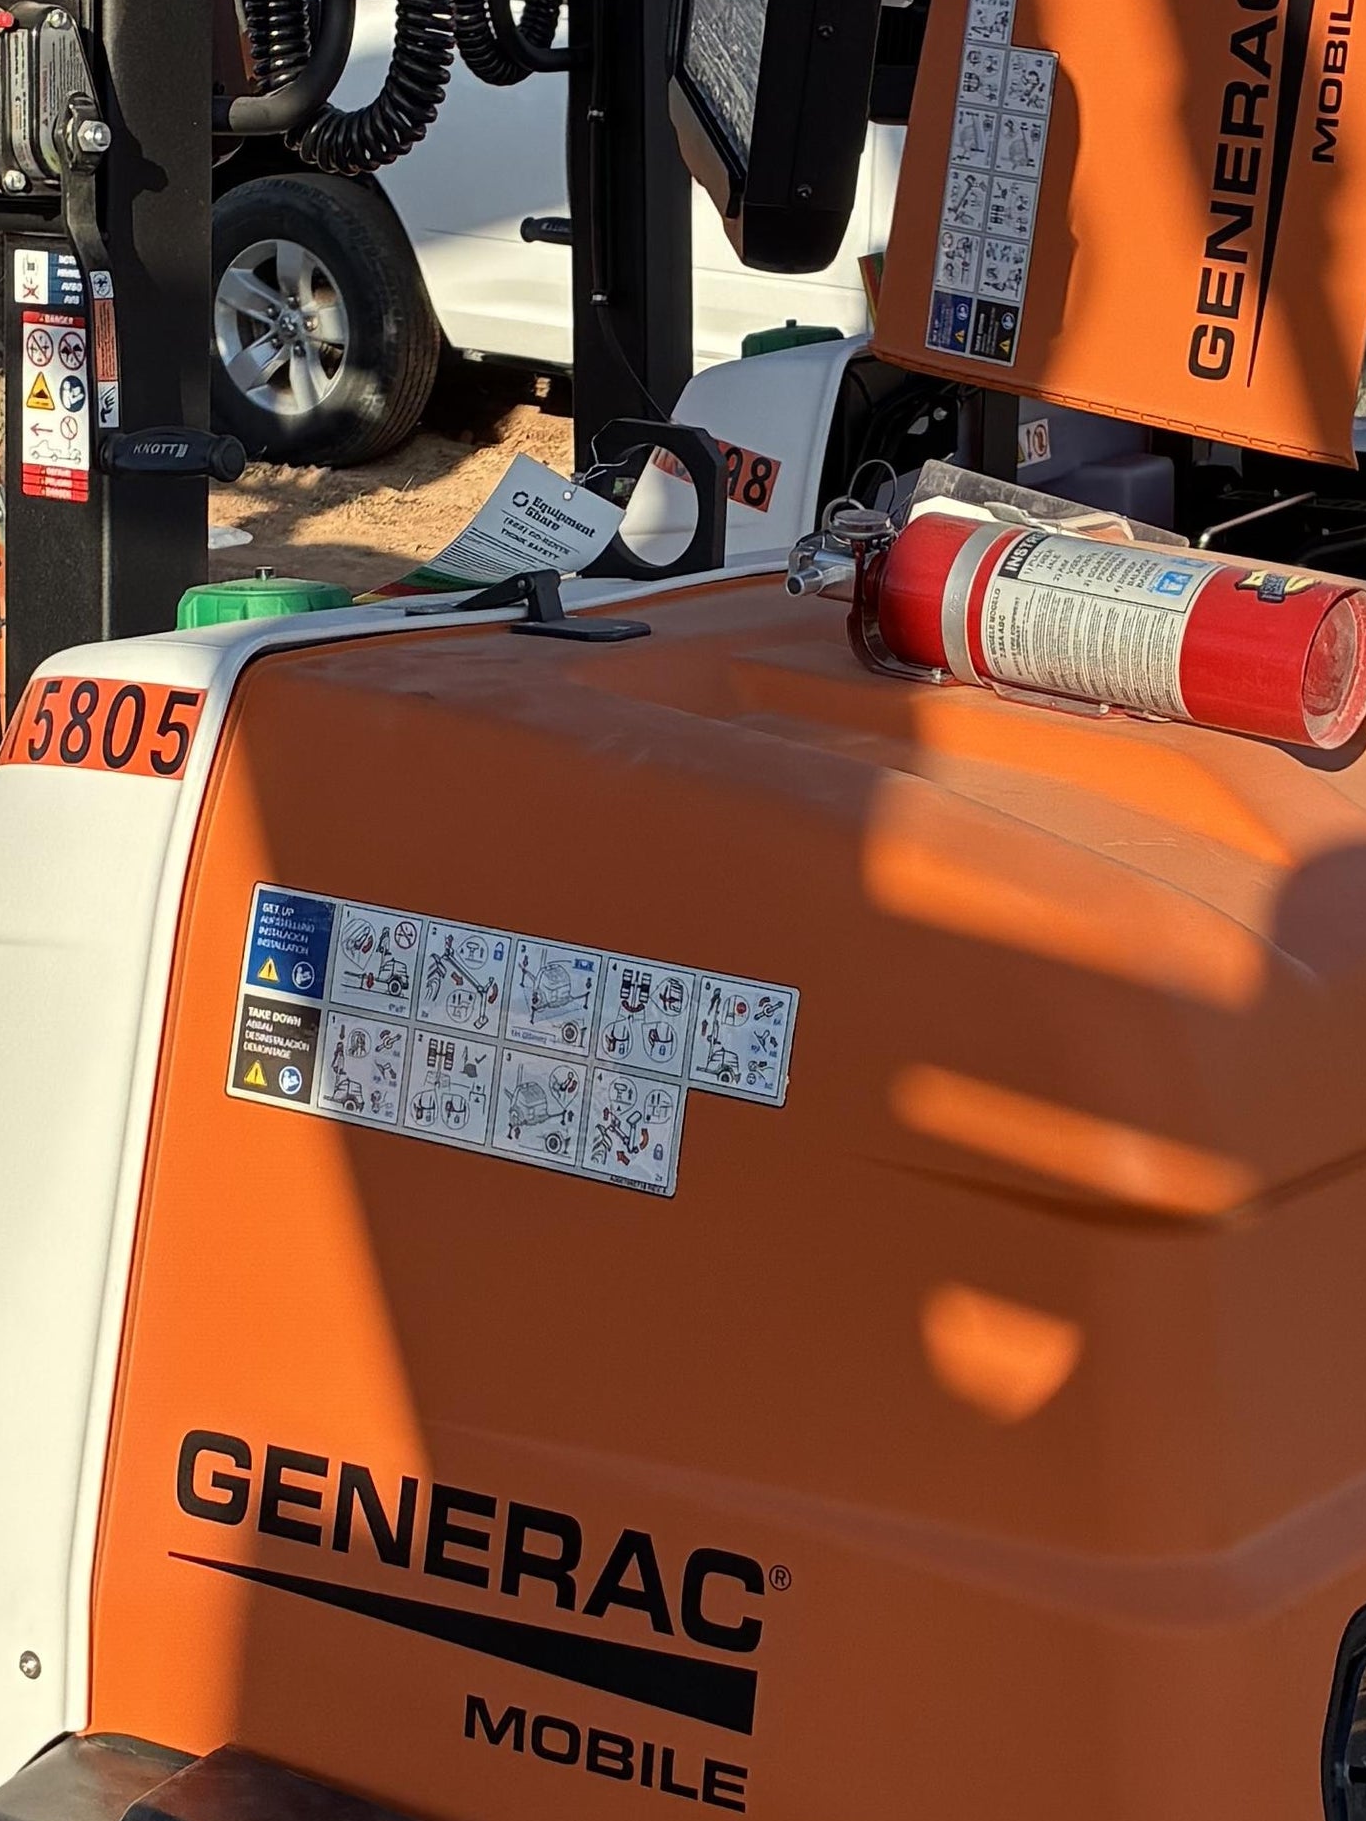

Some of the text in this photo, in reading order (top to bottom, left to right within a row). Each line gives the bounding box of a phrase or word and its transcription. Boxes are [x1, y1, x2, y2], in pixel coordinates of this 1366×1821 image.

[133, 443, 178, 456] KNOTT
[248, 1006, 302, 1027] TAKE DOWN
[176, 1429, 767, 1653] GENERAC
[464, 1694, 749, 1814] MOBILE
